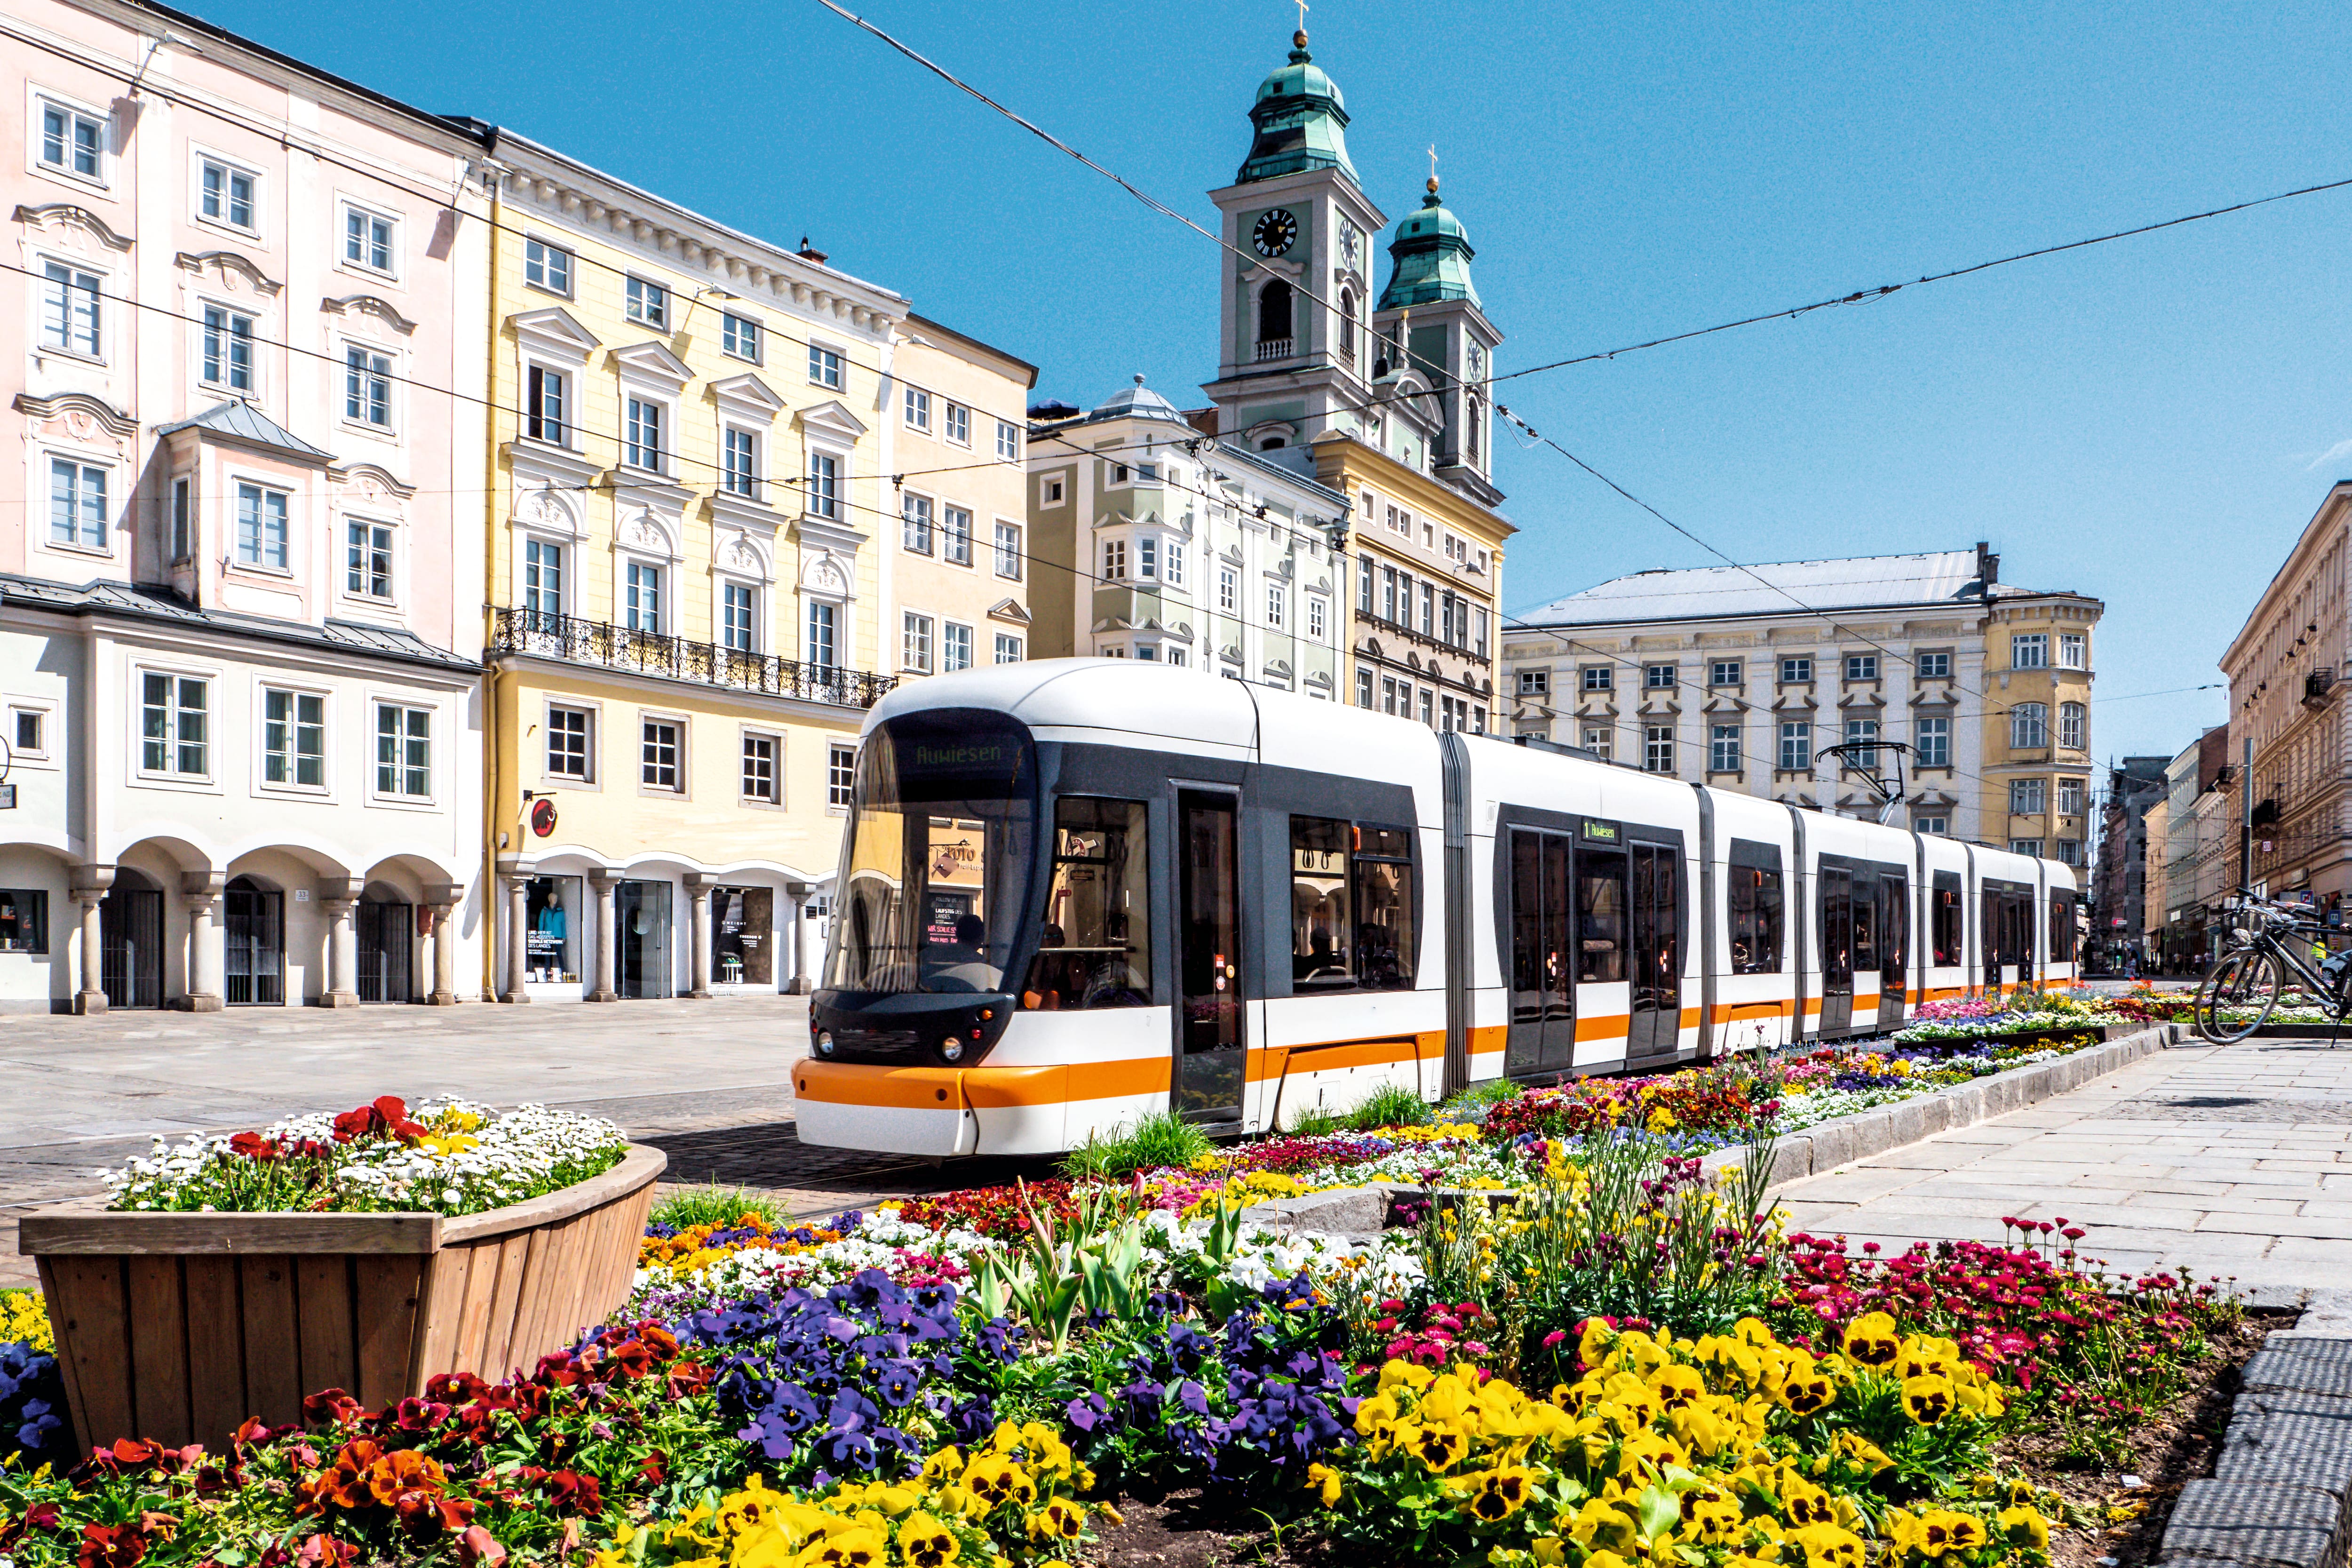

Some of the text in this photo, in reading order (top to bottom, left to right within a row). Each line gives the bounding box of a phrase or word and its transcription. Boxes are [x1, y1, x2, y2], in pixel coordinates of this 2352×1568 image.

[917, 745, 1001, 764] Auwiesen
[1584, 822, 1614, 838] 1 Auwiesen
